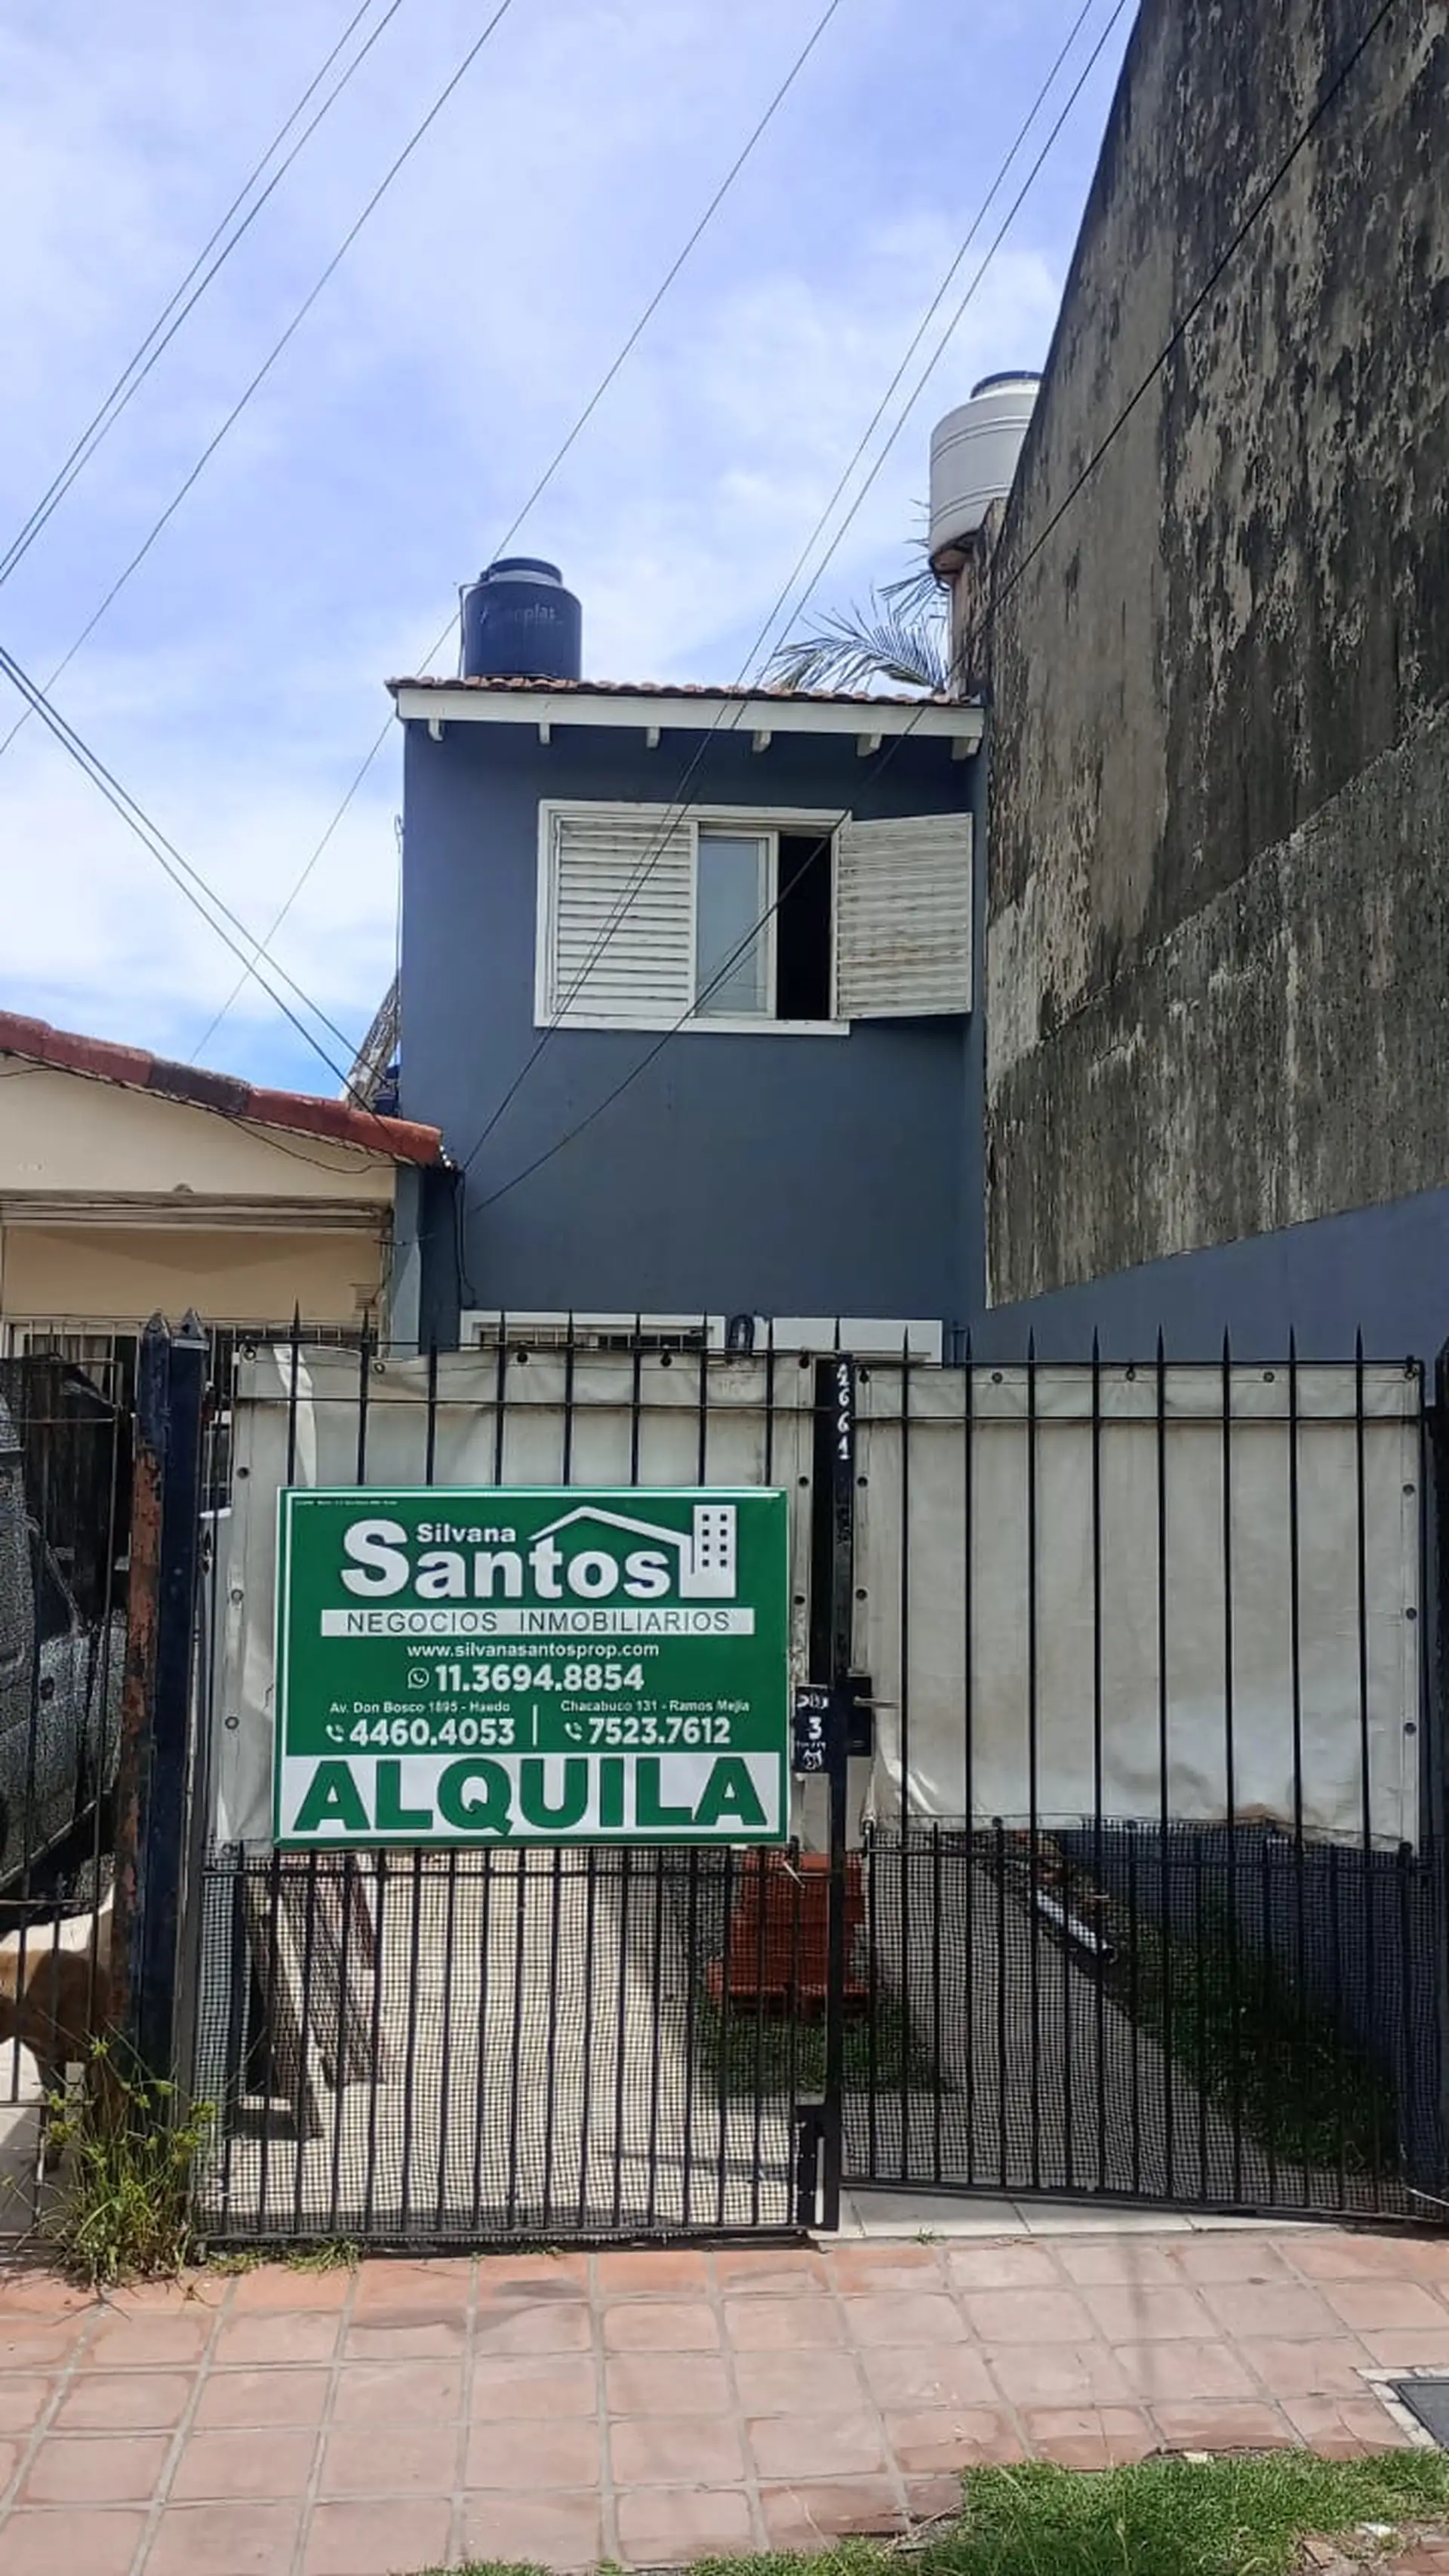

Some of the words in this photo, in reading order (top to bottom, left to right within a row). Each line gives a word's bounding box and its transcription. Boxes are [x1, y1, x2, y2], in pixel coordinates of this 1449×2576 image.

[417, 1523, 516, 1543] Silvana
[340, 1519, 672, 1599] Santos
[347, 1612, 497, 1633] NEGOCIOS
[520, 1611, 730, 1632] INMOBILIARIOS
[407, 1642, 660, 1660] www.silvanasantosprop.com
[435, 1663, 645, 1692] 11.3694.8854
[353, 1701, 380, 1713] Don
[383, 1701, 426, 1713] Bosco
[560, 1700, 632, 1712] Chacabuco
[636, 1700, 657, 1712] 131
[666, 1700, 712, 1712] Ramos
[349, 1717, 515, 1746] 4460.4053
[588, 1716, 731, 1745] 7523.7612
[293, 1757, 768, 1836] ALQUILA
